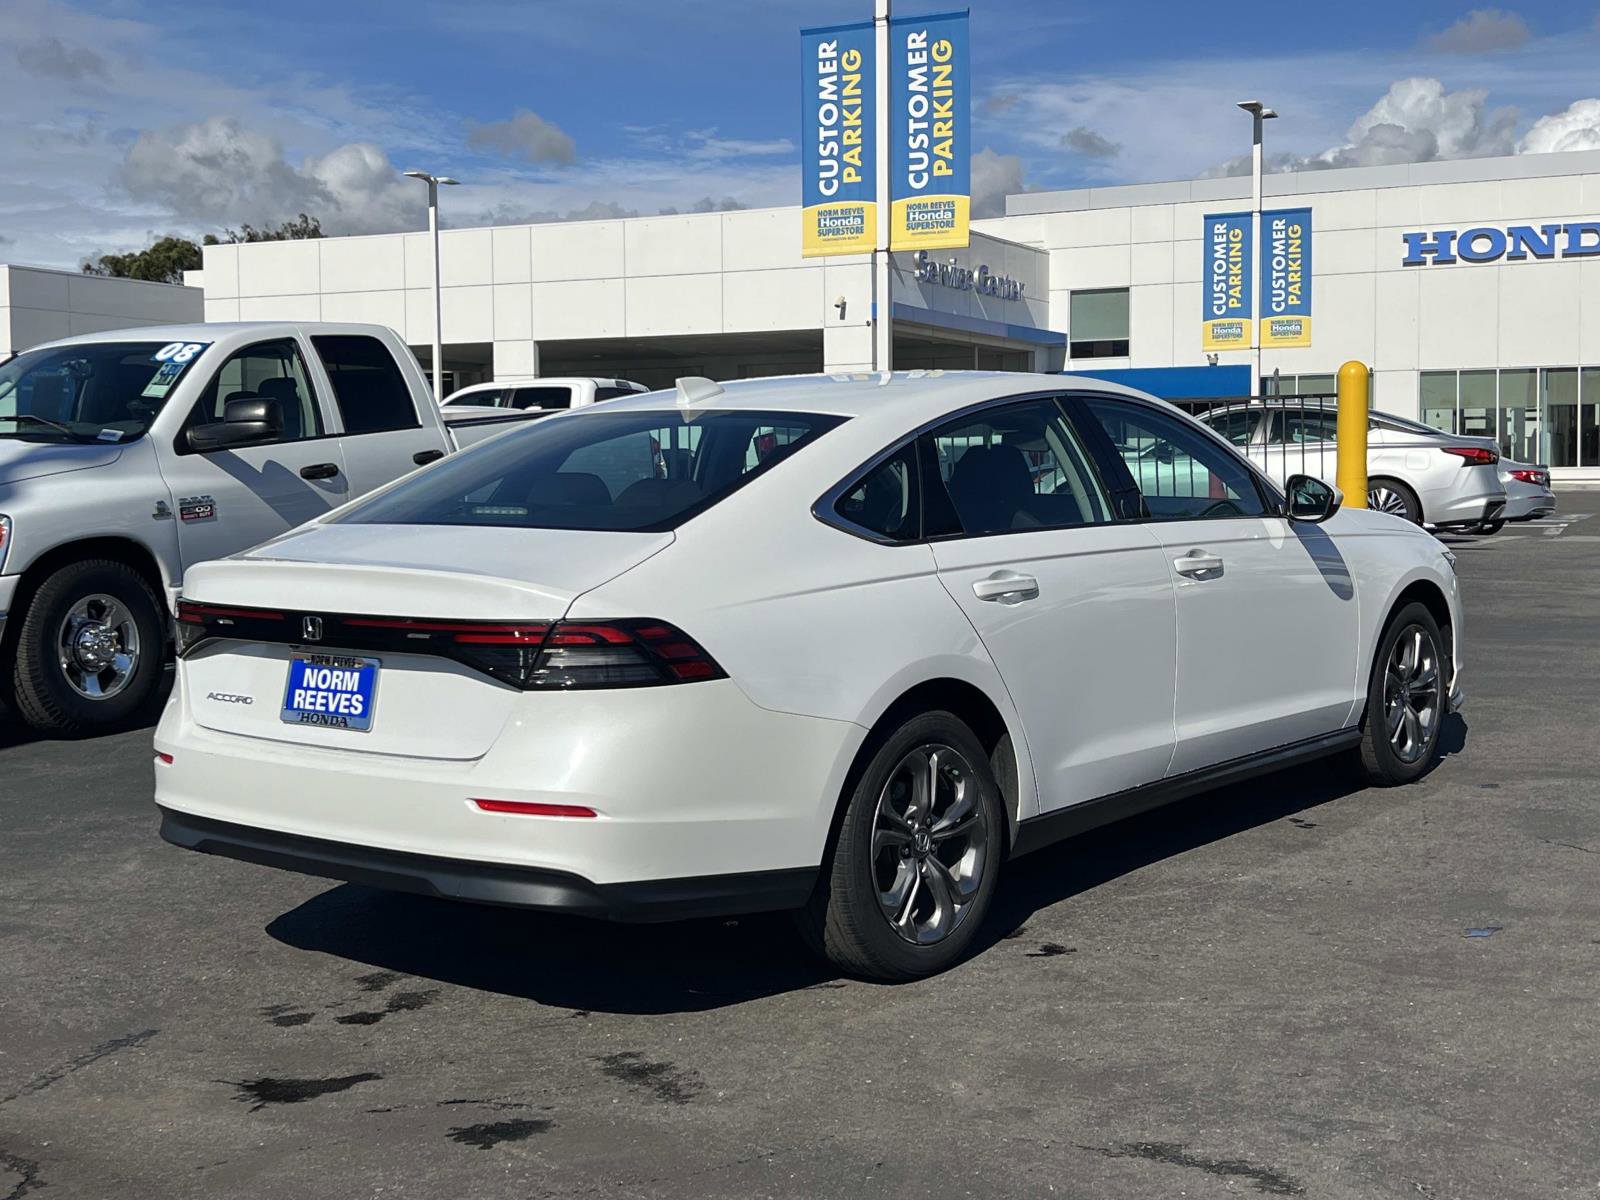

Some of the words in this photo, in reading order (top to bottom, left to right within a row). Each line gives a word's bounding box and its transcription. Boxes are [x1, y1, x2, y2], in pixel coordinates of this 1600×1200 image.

[818, 40, 839, 196] CUSTOMER
[841, 49, 862, 184] PARKING
[908, 30, 929, 189] CUSTOMER
[931, 39, 953, 177] PARKING
[817, 209, 838, 217] NORM
[840, 207, 864, 216] REEVES
[906, 203, 929, 211] NORM
[930, 201, 955, 209] REEVES
[909, 210, 952, 221] Honda
[817, 226, 864, 237] SUPERSTORE
[820, 217, 861, 227] Honda
[906, 220, 955, 231] SUPERSTORE
[914, 250, 974, 291] Service
[974, 265, 1025, 301] Center
[1213, 223, 1227, 315] CUSTOMER
[1229, 228, 1243, 308] PARKING
[1272, 219, 1286, 312] CUSTOMER
[1288, 224, 1302, 305] PARKING
[155, 342, 202, 362] 08
[303, 668, 360, 692] NORM
[206, 692, 253, 704] ACCORD
[293, 689, 363, 715] REEVES
[299, 712, 349, 728] HONDA
